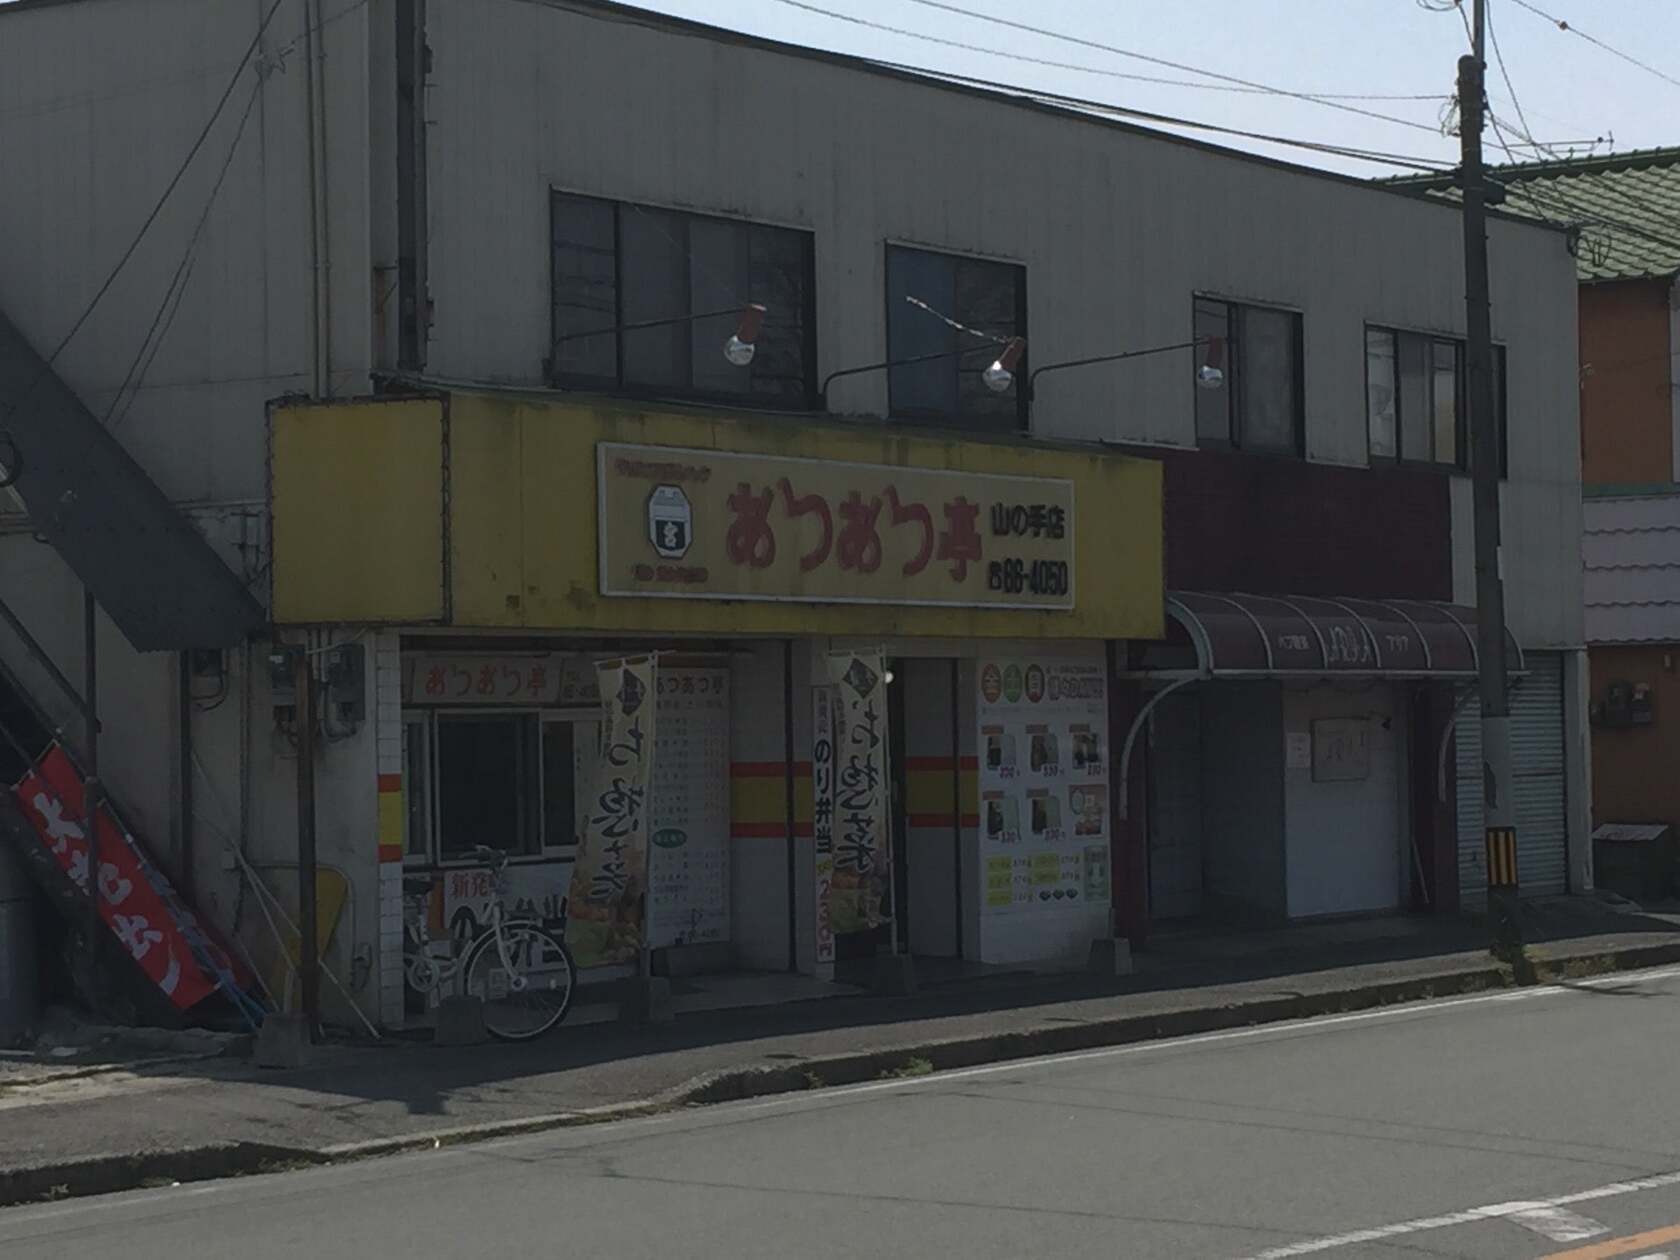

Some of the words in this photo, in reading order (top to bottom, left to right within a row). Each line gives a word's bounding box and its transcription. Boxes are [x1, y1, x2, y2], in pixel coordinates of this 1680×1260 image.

[724, 477, 983, 583] あつあつ亭
[989, 502, 1066, 540] 山の手店
[424, 663, 547, 698] あつあつ亭
[814, 739, 833, 854] のり弁当
